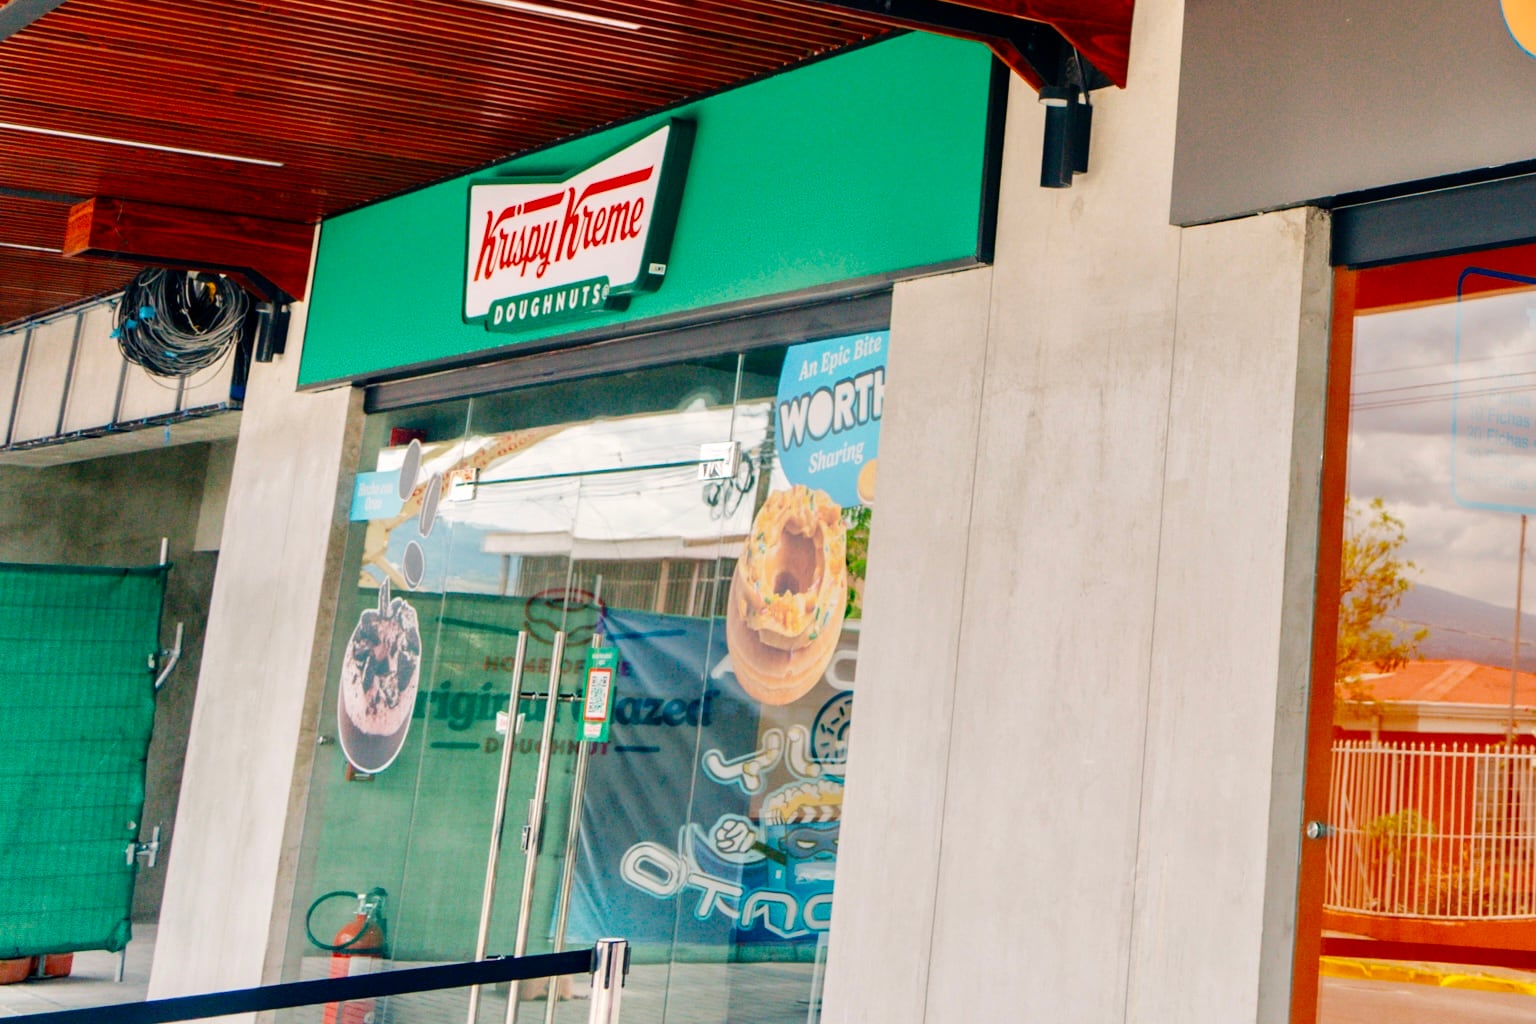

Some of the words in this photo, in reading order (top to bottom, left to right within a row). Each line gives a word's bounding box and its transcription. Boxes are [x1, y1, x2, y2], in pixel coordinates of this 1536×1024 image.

[473, 190, 565, 282] Krispy
[554, 164, 654, 263] Kreme
[798, 359, 819, 382] An
[821, 345, 851, 375] Epic
[853, 334, 882, 361] Bite
[808, 441, 865, 474] Sharing
